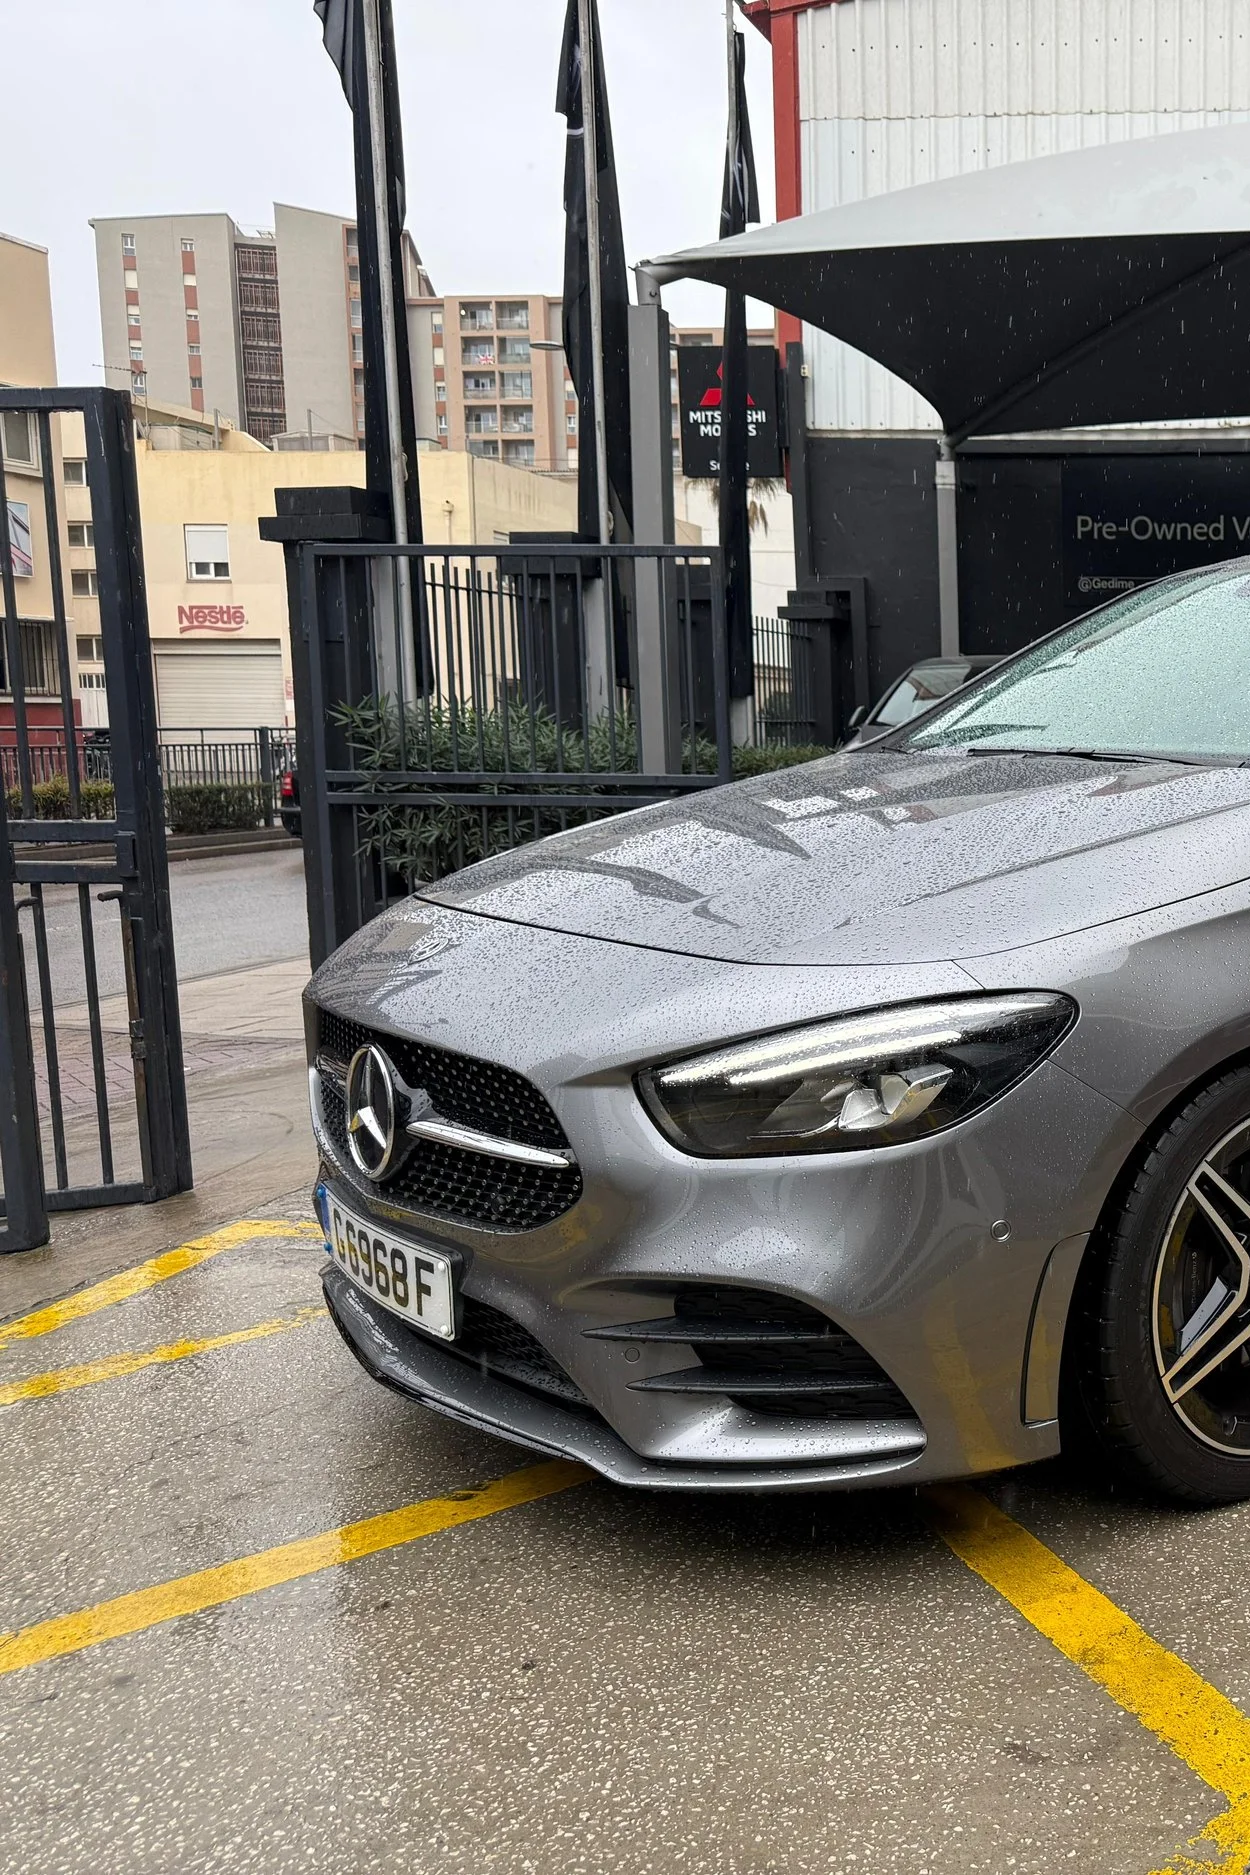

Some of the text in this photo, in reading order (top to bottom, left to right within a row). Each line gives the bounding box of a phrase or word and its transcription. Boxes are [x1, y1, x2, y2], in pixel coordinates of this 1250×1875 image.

[689, 410, 766, 424] MITSSHI
[700, 424, 757, 437] MOS
[1076, 515, 1225, 540] Pre-Owned
